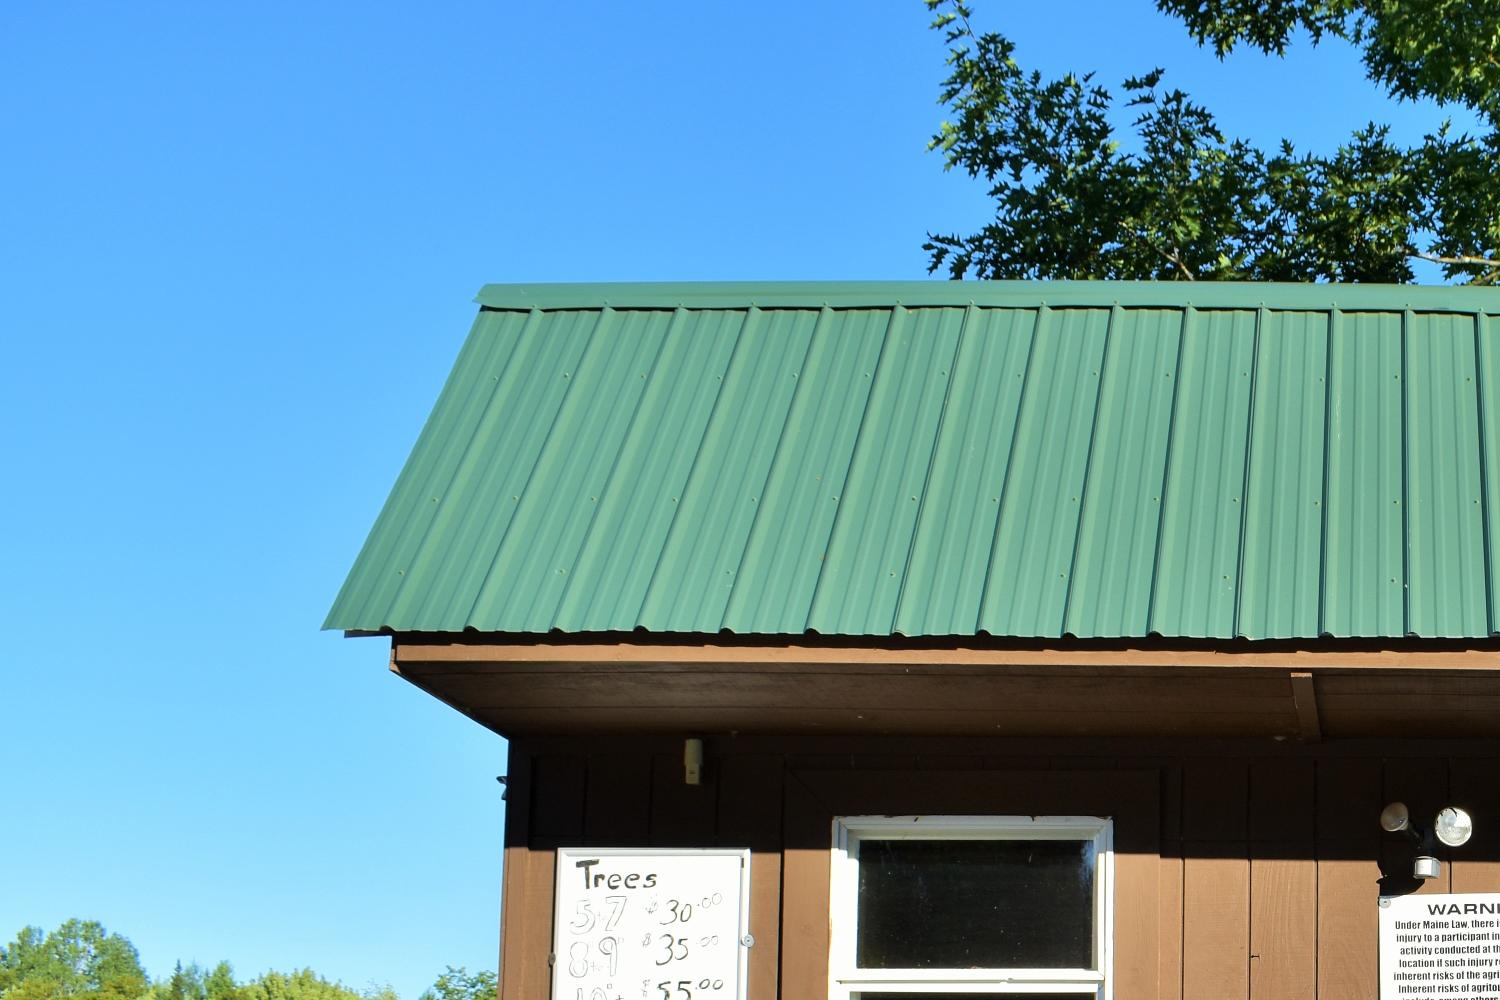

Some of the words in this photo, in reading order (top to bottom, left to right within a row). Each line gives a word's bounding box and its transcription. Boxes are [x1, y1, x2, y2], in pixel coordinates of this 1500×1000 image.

[576, 859, 657, 890] Trees
[1395, 921, 1421, 930] Under
[1423, 921, 1449, 929] Maine
[1451, 921, 1469, 929] Law,
[1471, 920, 1494, 928] there
[1396, 934, 1422, 943] injury
[1424, 934, 1433, 942] to
[1441, 933, 1490, 942] participant
[1492, 933, 1500, 941] in
[1400, 946, 1432, 955] activity
[1435, 946, 1481, 954] conducted
[1483, 946, 1491, 954] at
[1399, 959, 1435, 968] location
[1437, 959, 1443, 967] if
[1445, 958, 1465, 967] such
[1467, 958, 1493, 968] injury
[1394, 972, 1431, 980] inherent
[1433, 971, 1454, 980] risks
[1456, 971, 1465, 979] of
[1467, 971, 1481, 979] the
[1398, 985, 1436, 993] Inherent
[1438, 984, 1459, 992] risks
[1461, 984, 1470, 992] of
